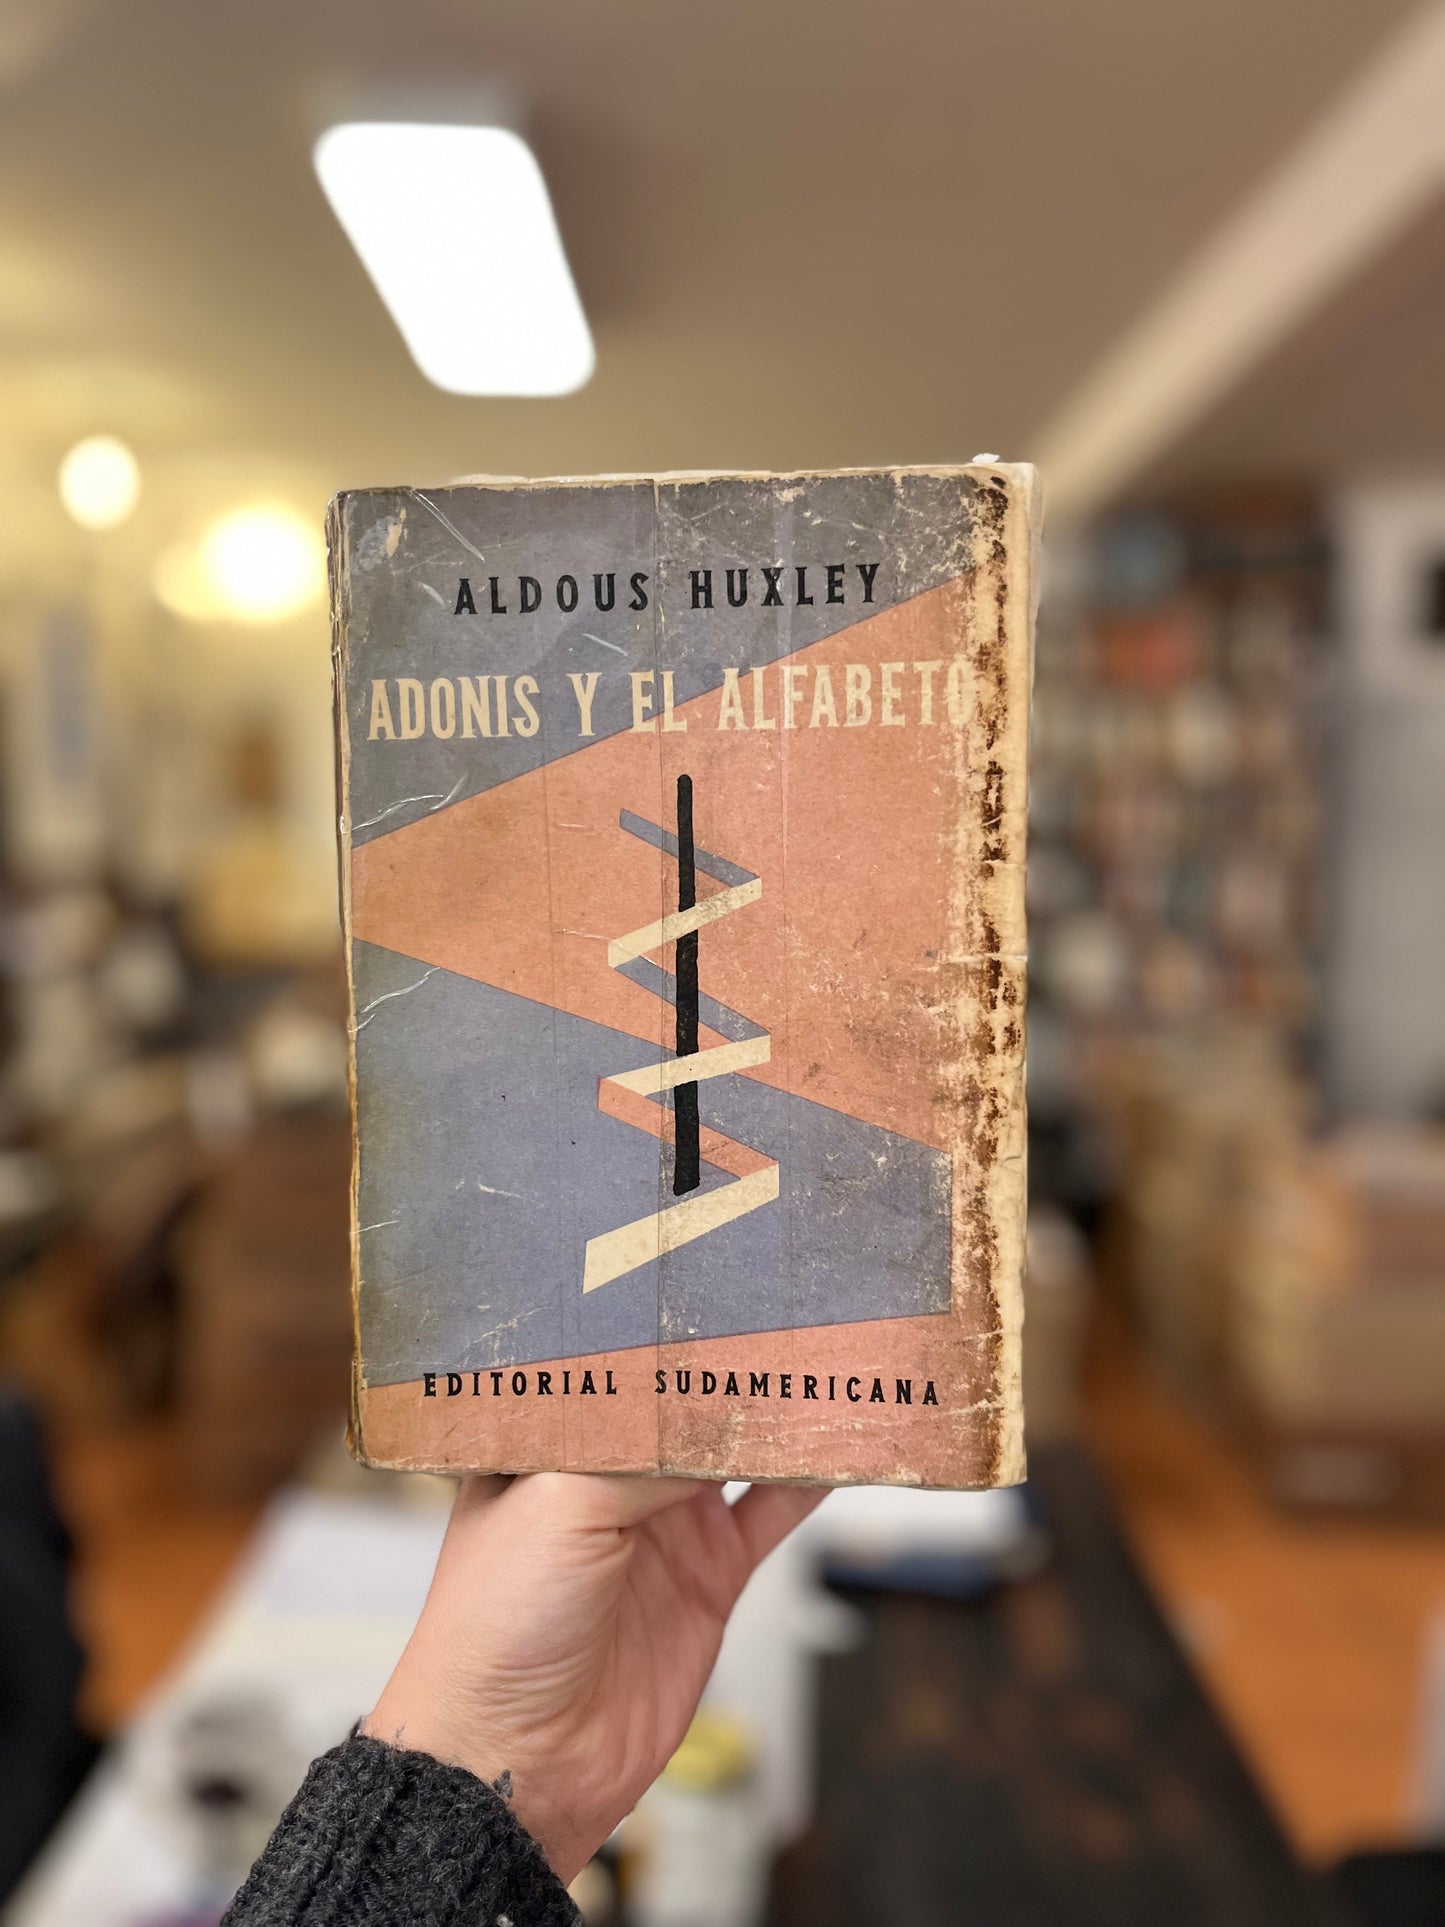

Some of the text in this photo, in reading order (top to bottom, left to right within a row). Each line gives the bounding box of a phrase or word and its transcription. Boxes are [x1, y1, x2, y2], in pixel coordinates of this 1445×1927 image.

[454, 563, 881, 615] ALDOUS HUXLEY
[366, 656, 977, 742] ADONIS Y EL ALFABETO
[423, 1369, 939, 1406] EDITORIAL SUDAMERICANA
